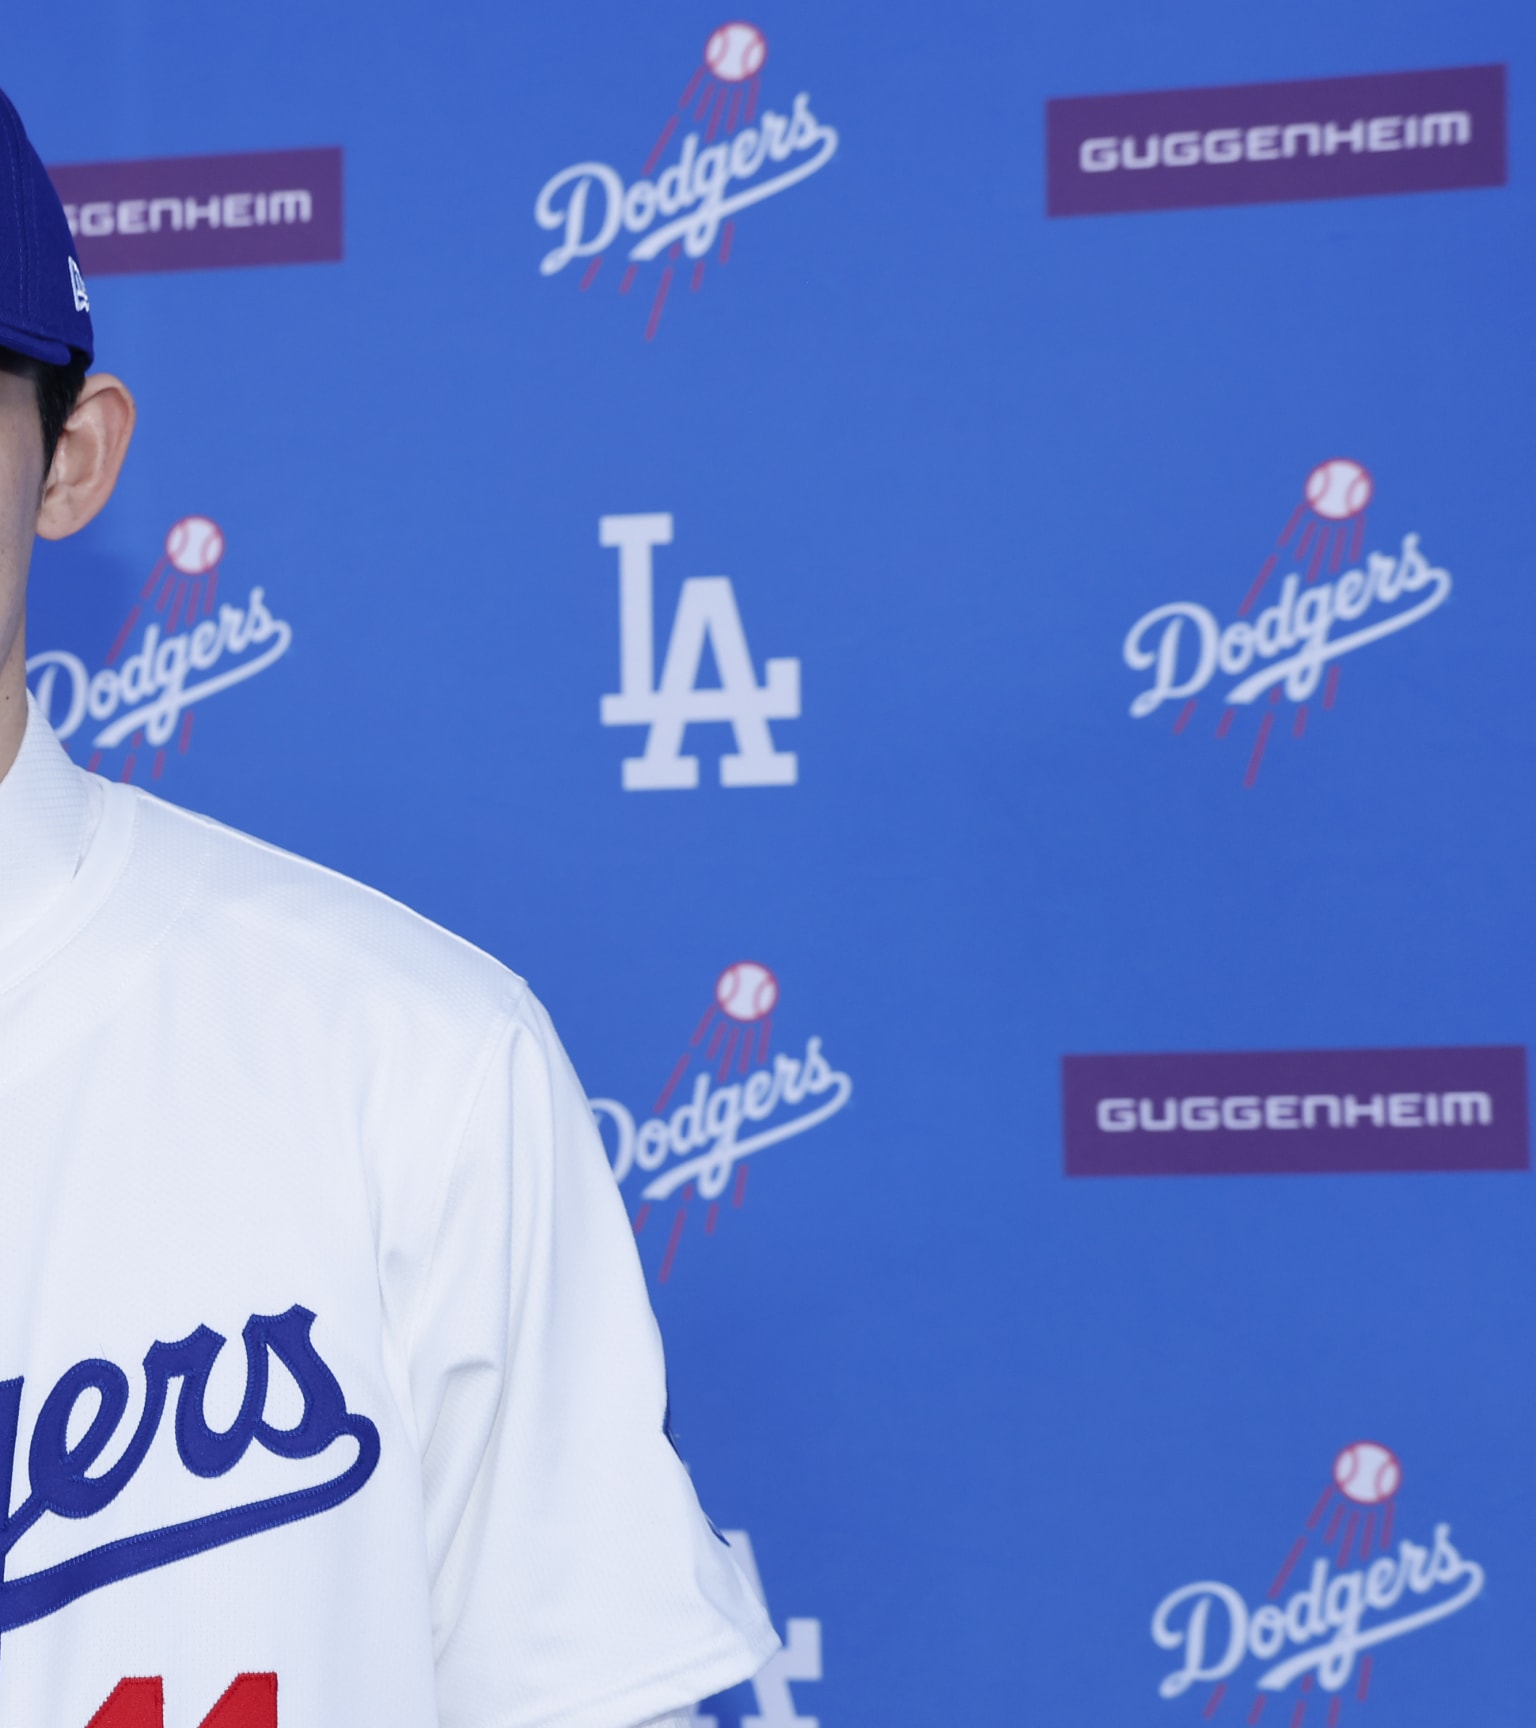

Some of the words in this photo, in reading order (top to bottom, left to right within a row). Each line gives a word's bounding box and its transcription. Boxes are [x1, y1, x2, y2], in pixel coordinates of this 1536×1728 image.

[64, 189, 312, 237] GENHEIM
[534, 92, 839, 276] Dodgers
[1079, 111, 1472, 173] GUGGENHEIM
[26, 586, 293, 749] Dodgers
[599, 511, 802, 791] LA
[1122, 532, 1452, 718] Dodgers
[1097, 1091, 1493, 1133] GUGGENHEIM
[1151, 1523, 1485, 1699] Dodgers
